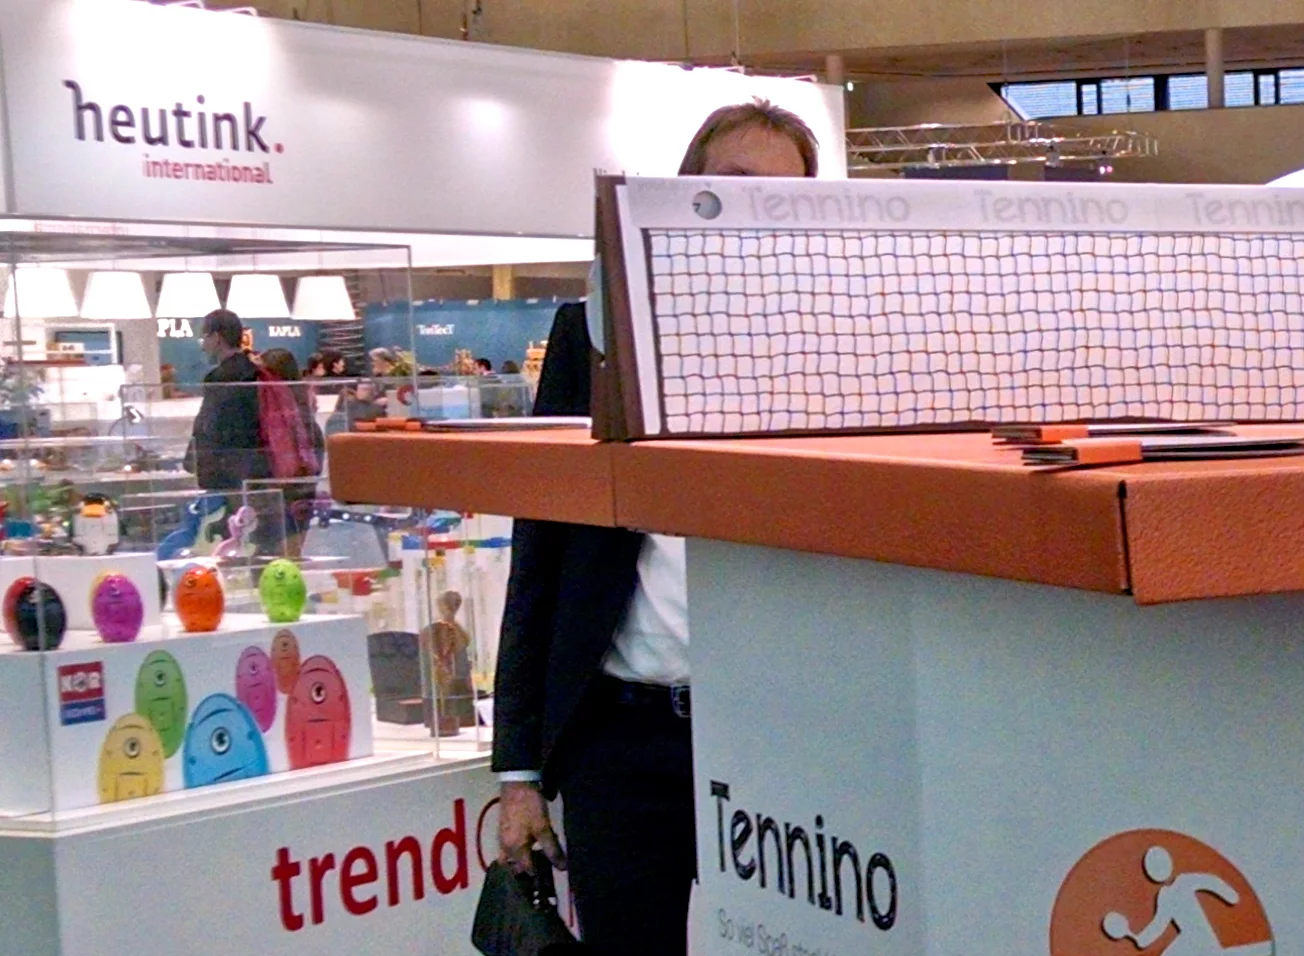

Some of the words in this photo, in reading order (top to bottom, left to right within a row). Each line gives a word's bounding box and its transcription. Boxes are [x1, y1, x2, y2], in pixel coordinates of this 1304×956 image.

[142, 153, 274, 184] international
[741, 185, 909, 221] Tennino
[973, 188, 1129, 226] Tennino
[709, 779, 898, 932] Tennino
